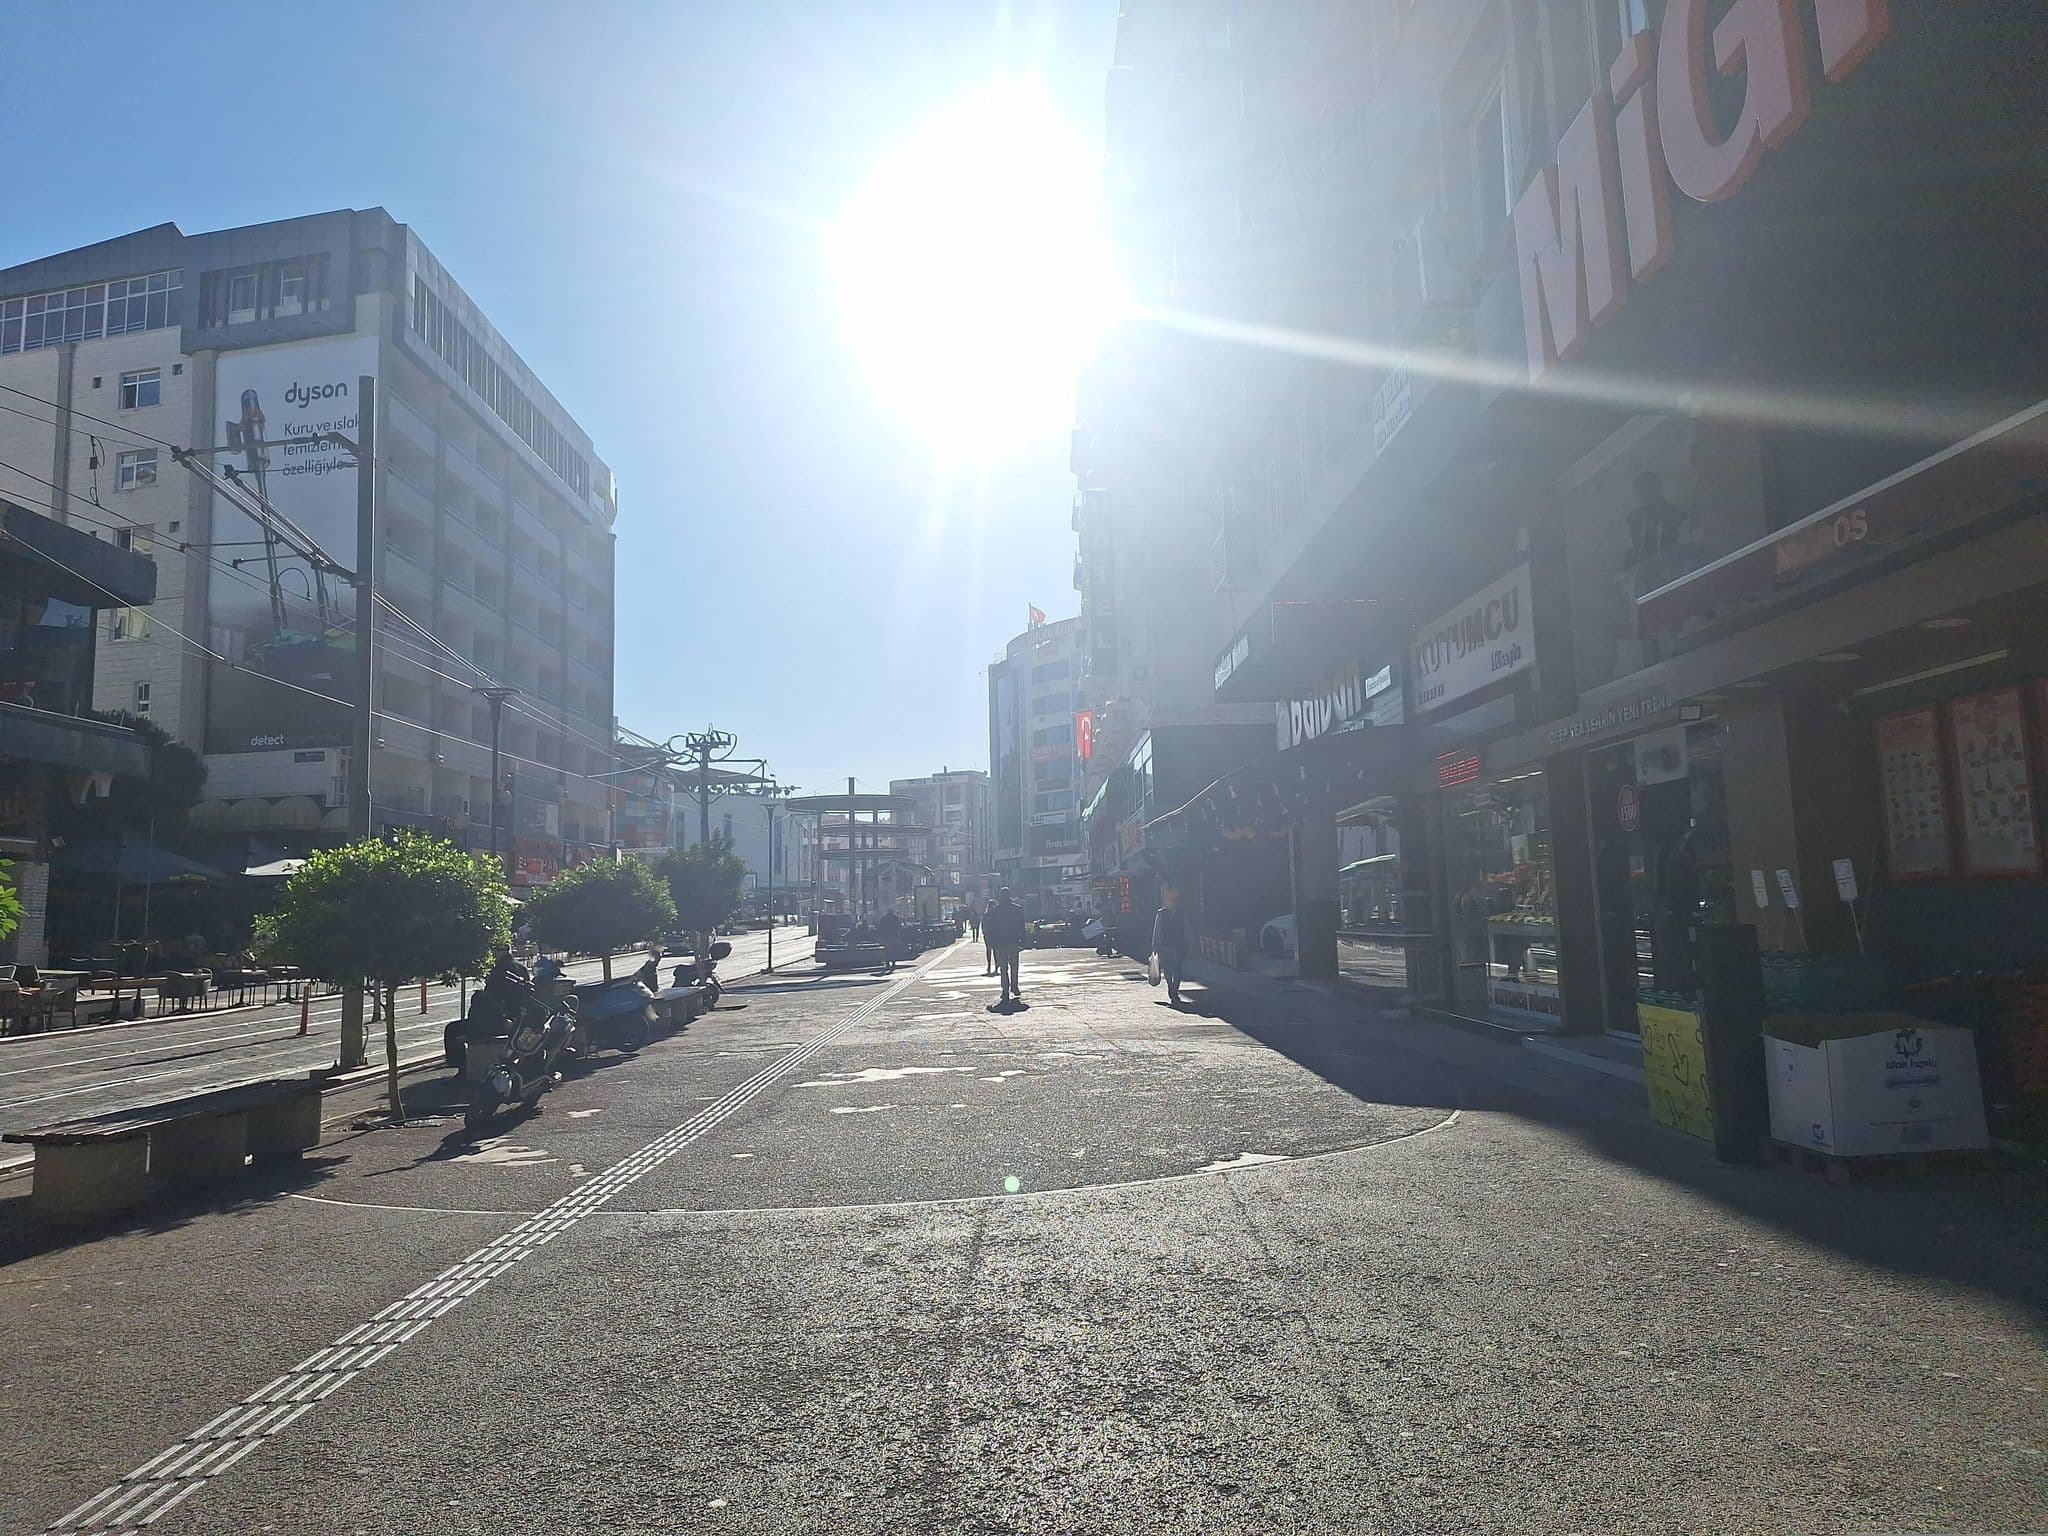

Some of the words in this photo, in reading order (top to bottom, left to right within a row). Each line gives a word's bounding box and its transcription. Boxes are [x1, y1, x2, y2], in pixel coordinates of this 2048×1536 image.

[284, 382, 348, 408] dyson
[284, 422, 313, 436] Kuru
[316, 421, 331, 431] ve
[250, 733, 285, 746] detect
